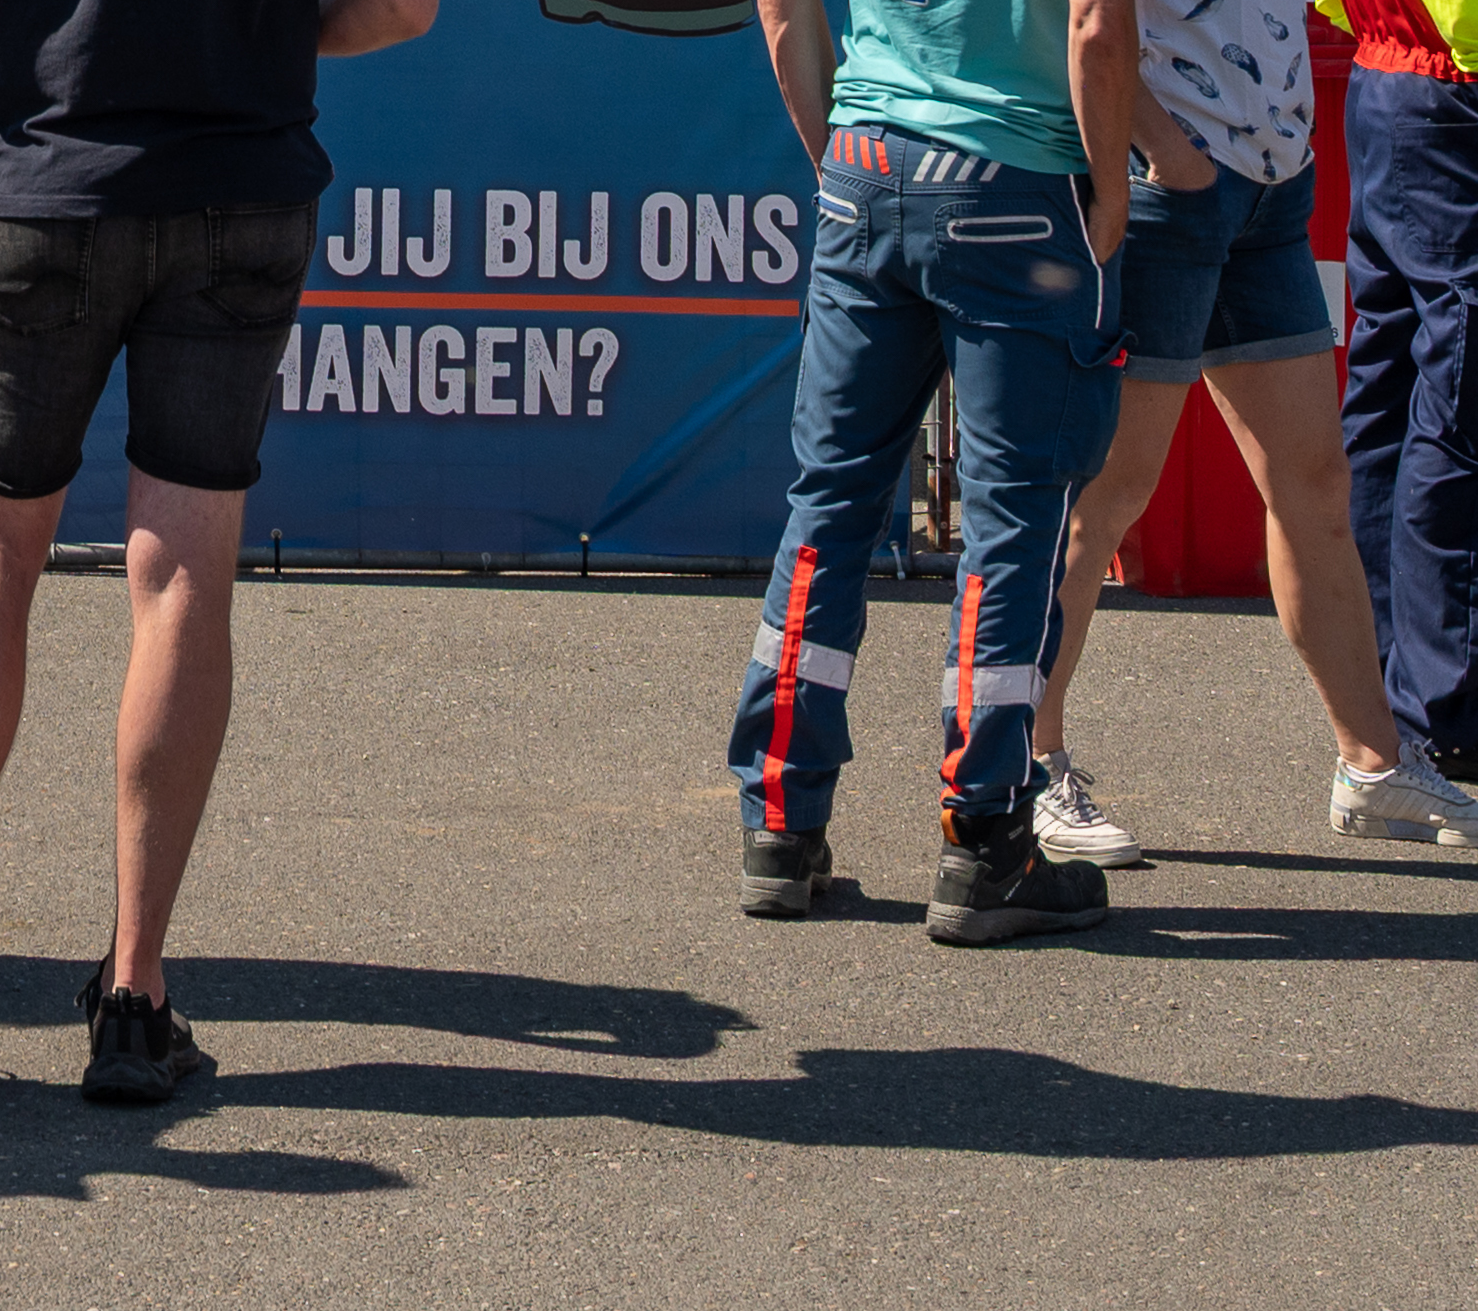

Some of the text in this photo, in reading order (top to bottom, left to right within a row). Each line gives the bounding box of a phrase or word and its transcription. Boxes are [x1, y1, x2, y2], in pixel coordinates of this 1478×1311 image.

[326, 187, 799, 284] JIJ BIJ ONS
